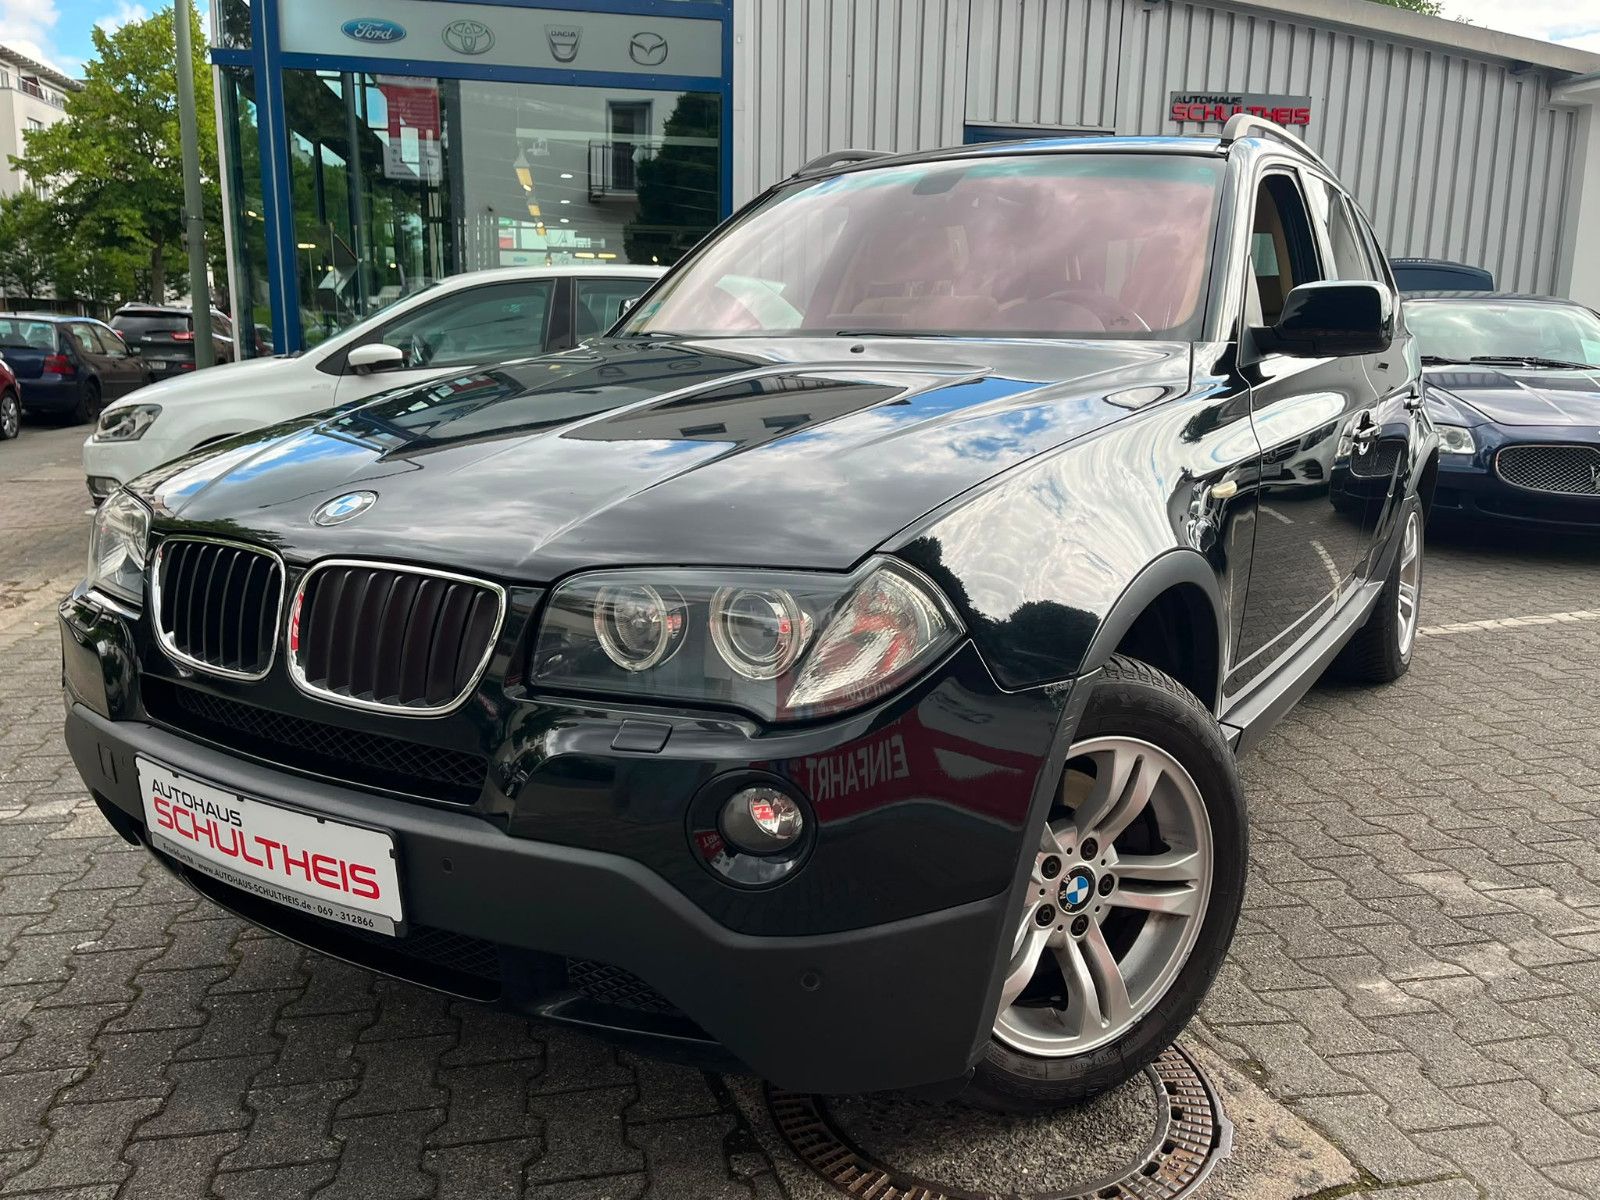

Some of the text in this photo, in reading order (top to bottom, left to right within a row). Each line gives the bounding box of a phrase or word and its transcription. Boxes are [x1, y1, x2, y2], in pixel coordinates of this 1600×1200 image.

[354, 21, 393, 40] Ford
[551, 30, 577, 38] DACIA
[1174, 95, 1243, 104] AUTOHAUS
[152, 778, 243, 828] AUTOHAUS
[153, 796, 381, 900] SCHULTHEIS
[317, 905, 333, 917] 069
[340, 911, 374, 928] 312866
